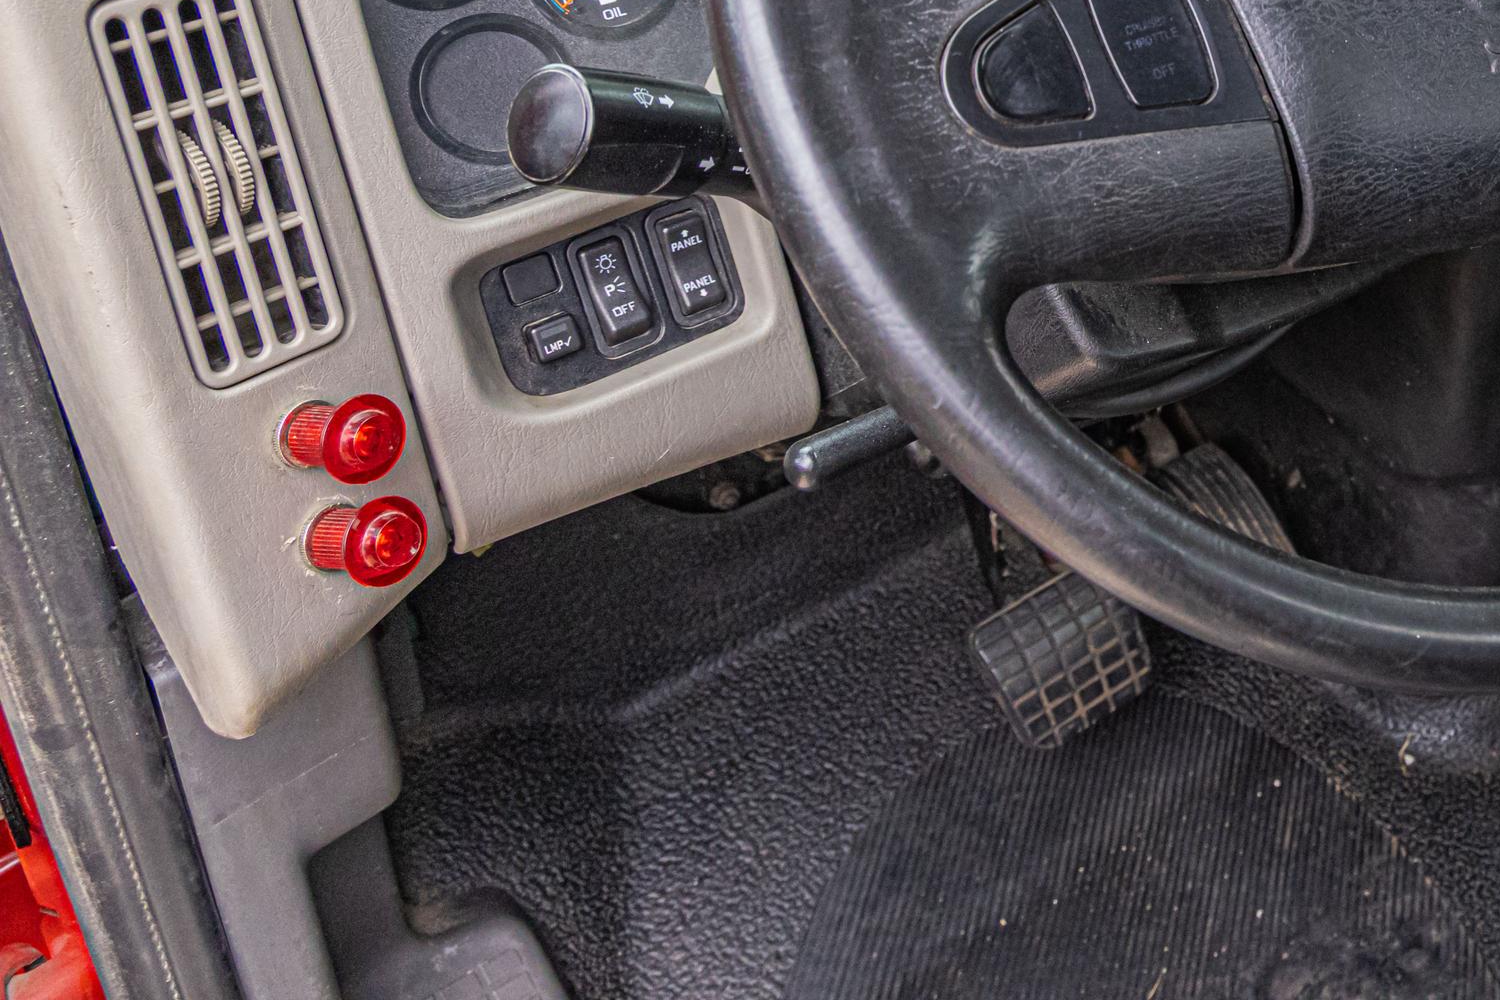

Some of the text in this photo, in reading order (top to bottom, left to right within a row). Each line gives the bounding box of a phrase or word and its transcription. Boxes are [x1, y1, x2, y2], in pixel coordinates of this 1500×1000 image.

[602, 6, 627, 20] OIL
[1125, 27, 1179, 51] THROTTLE
[1152, 62, 1177, 80] OFF
[671, 233, 703, 253] PANEL
[683, 273, 716, 293] PANEL
[612, 301, 636, 318] OFF
